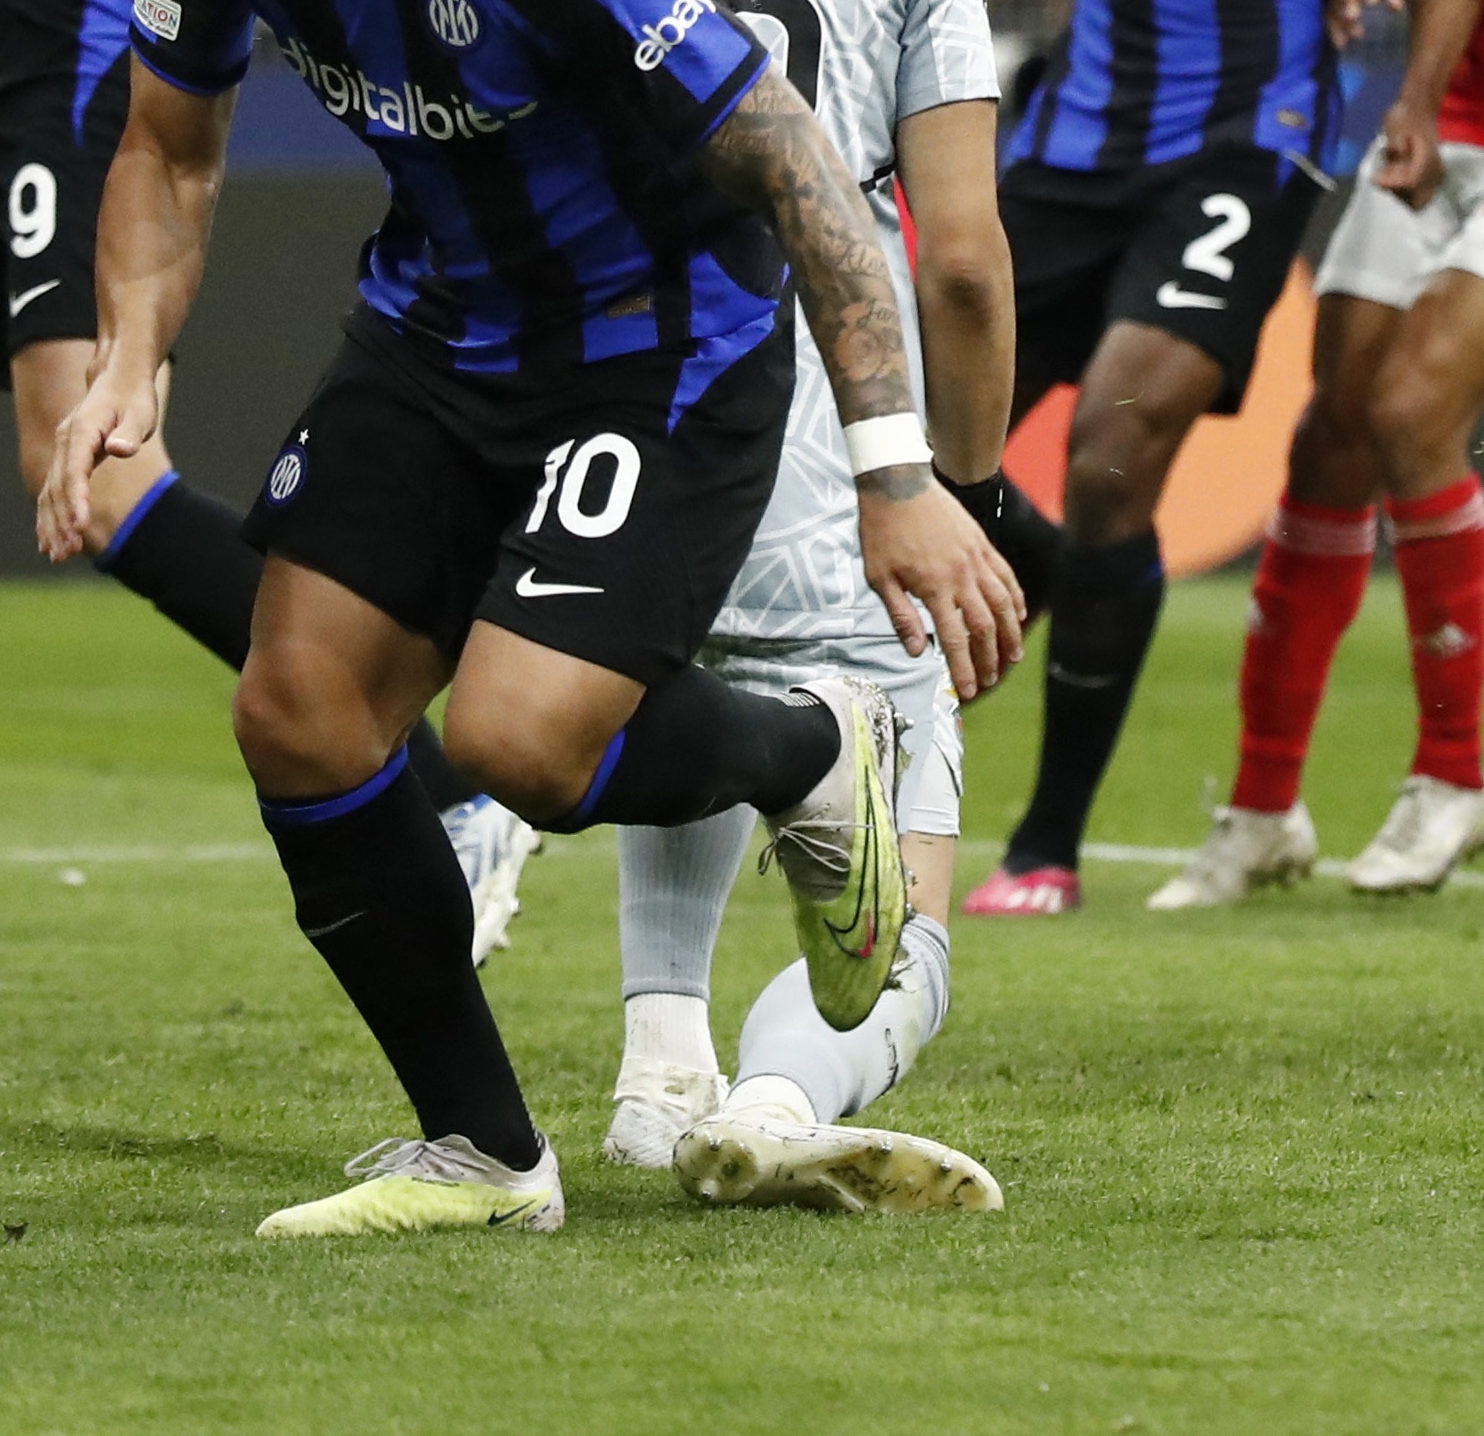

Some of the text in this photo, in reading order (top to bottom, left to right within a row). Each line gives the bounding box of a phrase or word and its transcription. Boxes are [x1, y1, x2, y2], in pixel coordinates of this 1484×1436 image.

[8, 162, 58, 260] 9
[1182, 192, 1252, 283] 2
[524, 431, 643, 539] 10
